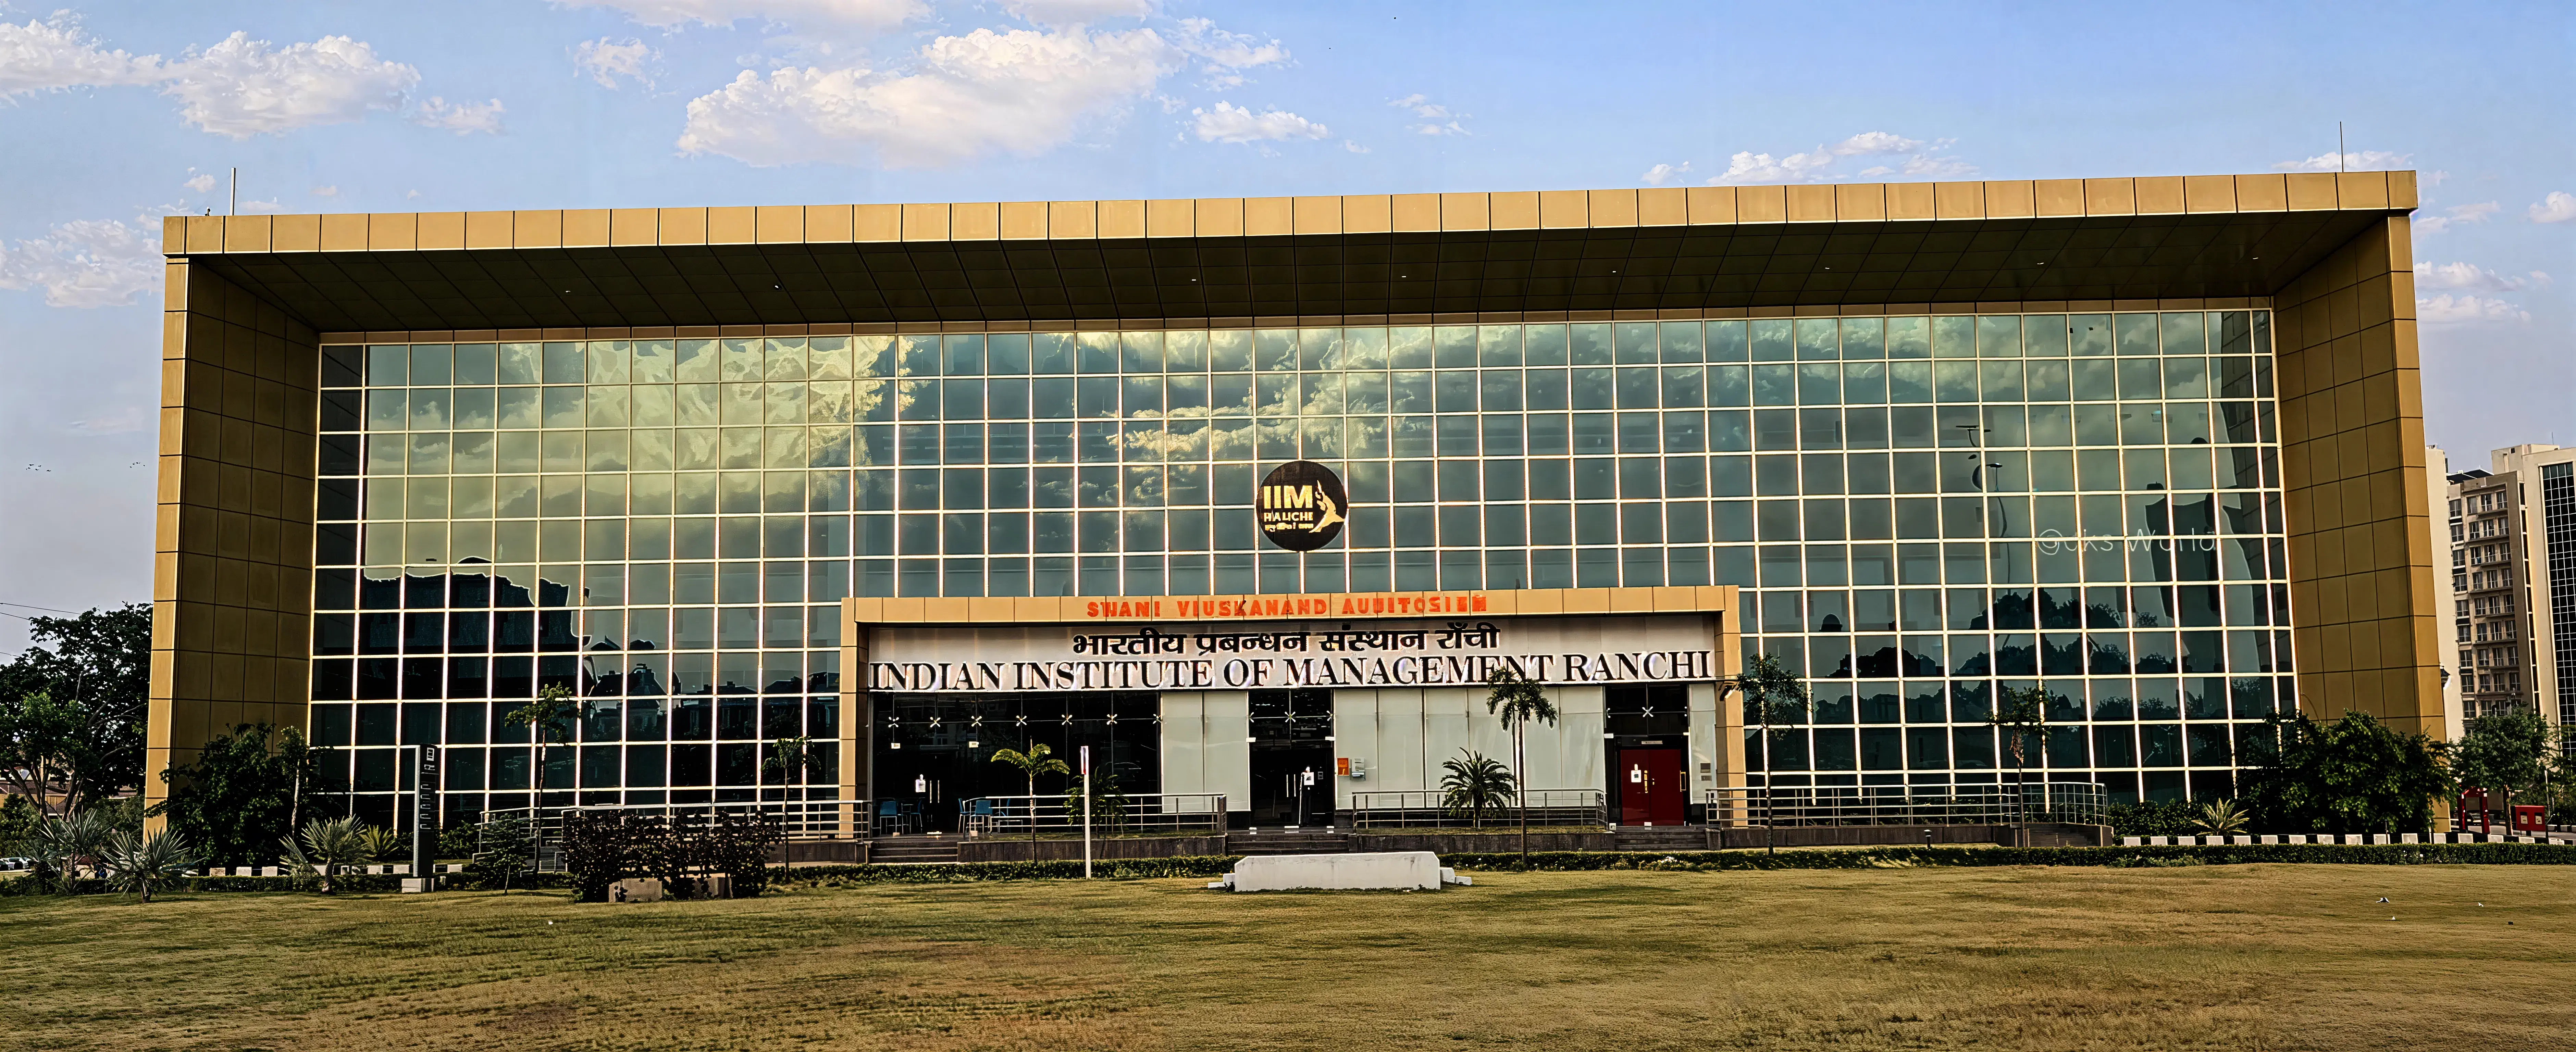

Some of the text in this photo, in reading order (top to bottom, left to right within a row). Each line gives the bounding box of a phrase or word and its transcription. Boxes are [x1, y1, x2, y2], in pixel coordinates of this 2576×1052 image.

[1263, 485, 1313, 509] IIM
[1073, 622, 1501, 656] भारतीय प्रबन्धन संस्थान राँची
[869, 651, 1712, 690] INDIAN INSTITUTE OF MANAGEMENT RANCHI
